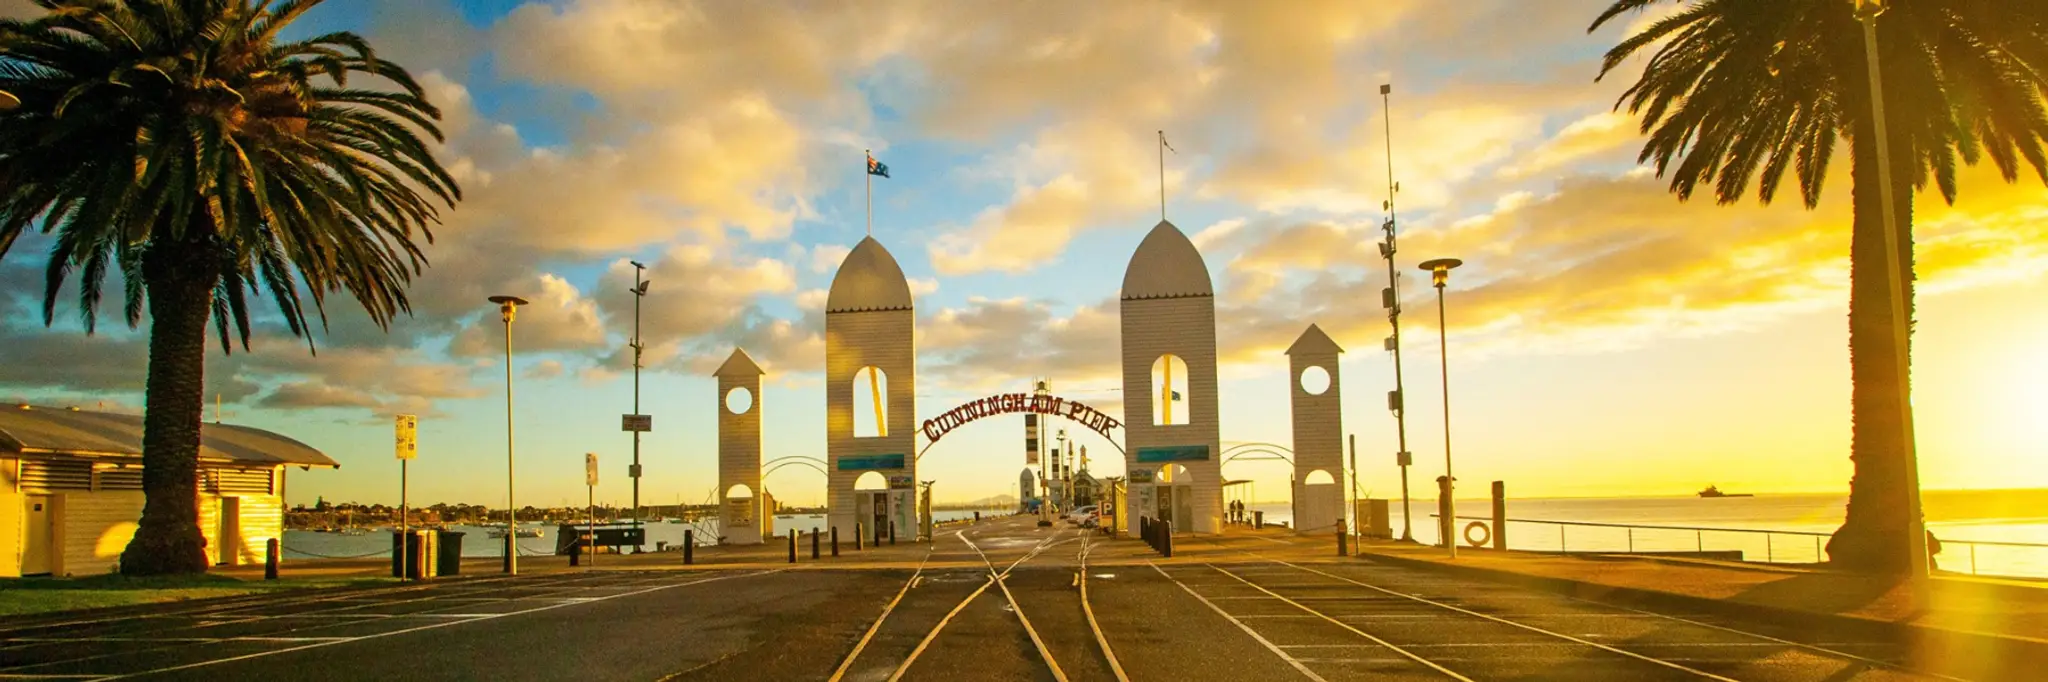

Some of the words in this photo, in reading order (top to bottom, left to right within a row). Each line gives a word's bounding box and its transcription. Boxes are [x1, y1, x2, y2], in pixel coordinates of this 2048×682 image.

[923, 393, 1063, 442] CUNNINGHAM
[1066, 401, 1118, 439] PIER
[1103, 502, 1112, 515] P
